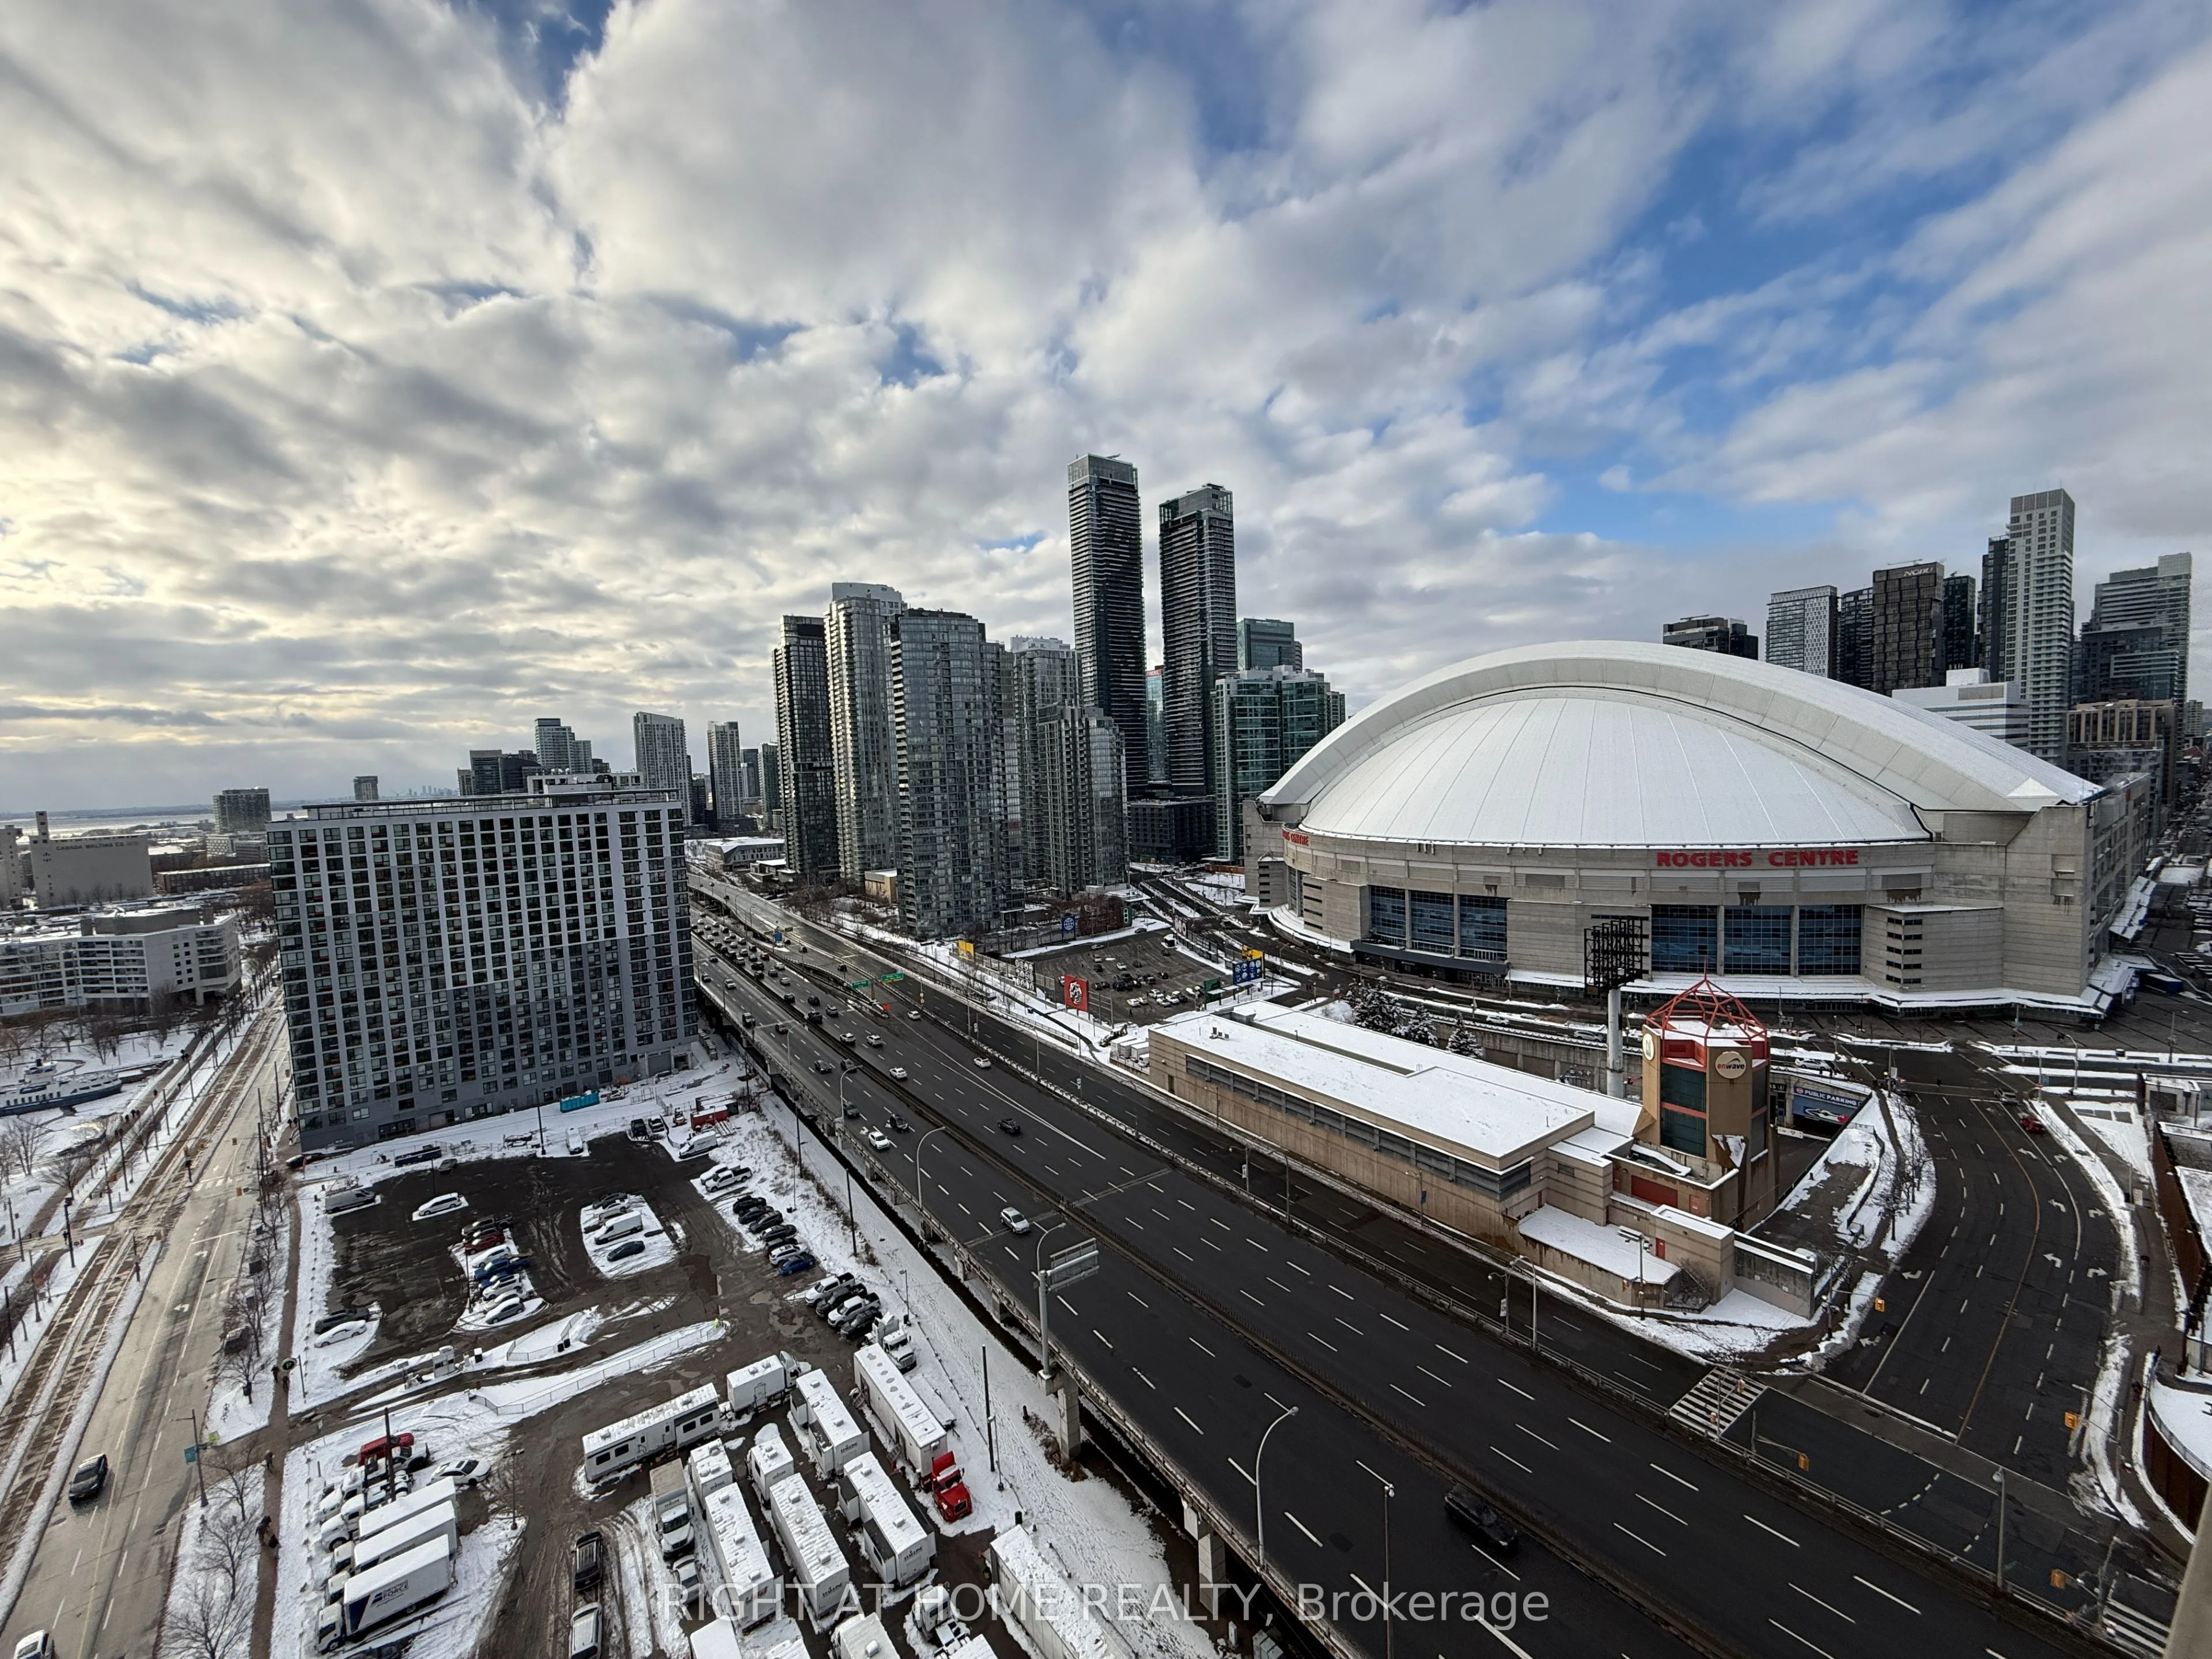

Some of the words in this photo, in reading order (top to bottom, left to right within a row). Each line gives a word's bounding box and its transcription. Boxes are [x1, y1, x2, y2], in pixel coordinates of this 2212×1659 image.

[1903, 567, 1934, 577] NOBU
[1656, 851, 1752, 867] ROGERS
[1768, 850, 1859, 866] CENTRE
[1804, 1090, 1826, 1099] PUBLIC
[1826, 1094, 1857, 1106] PARKING
